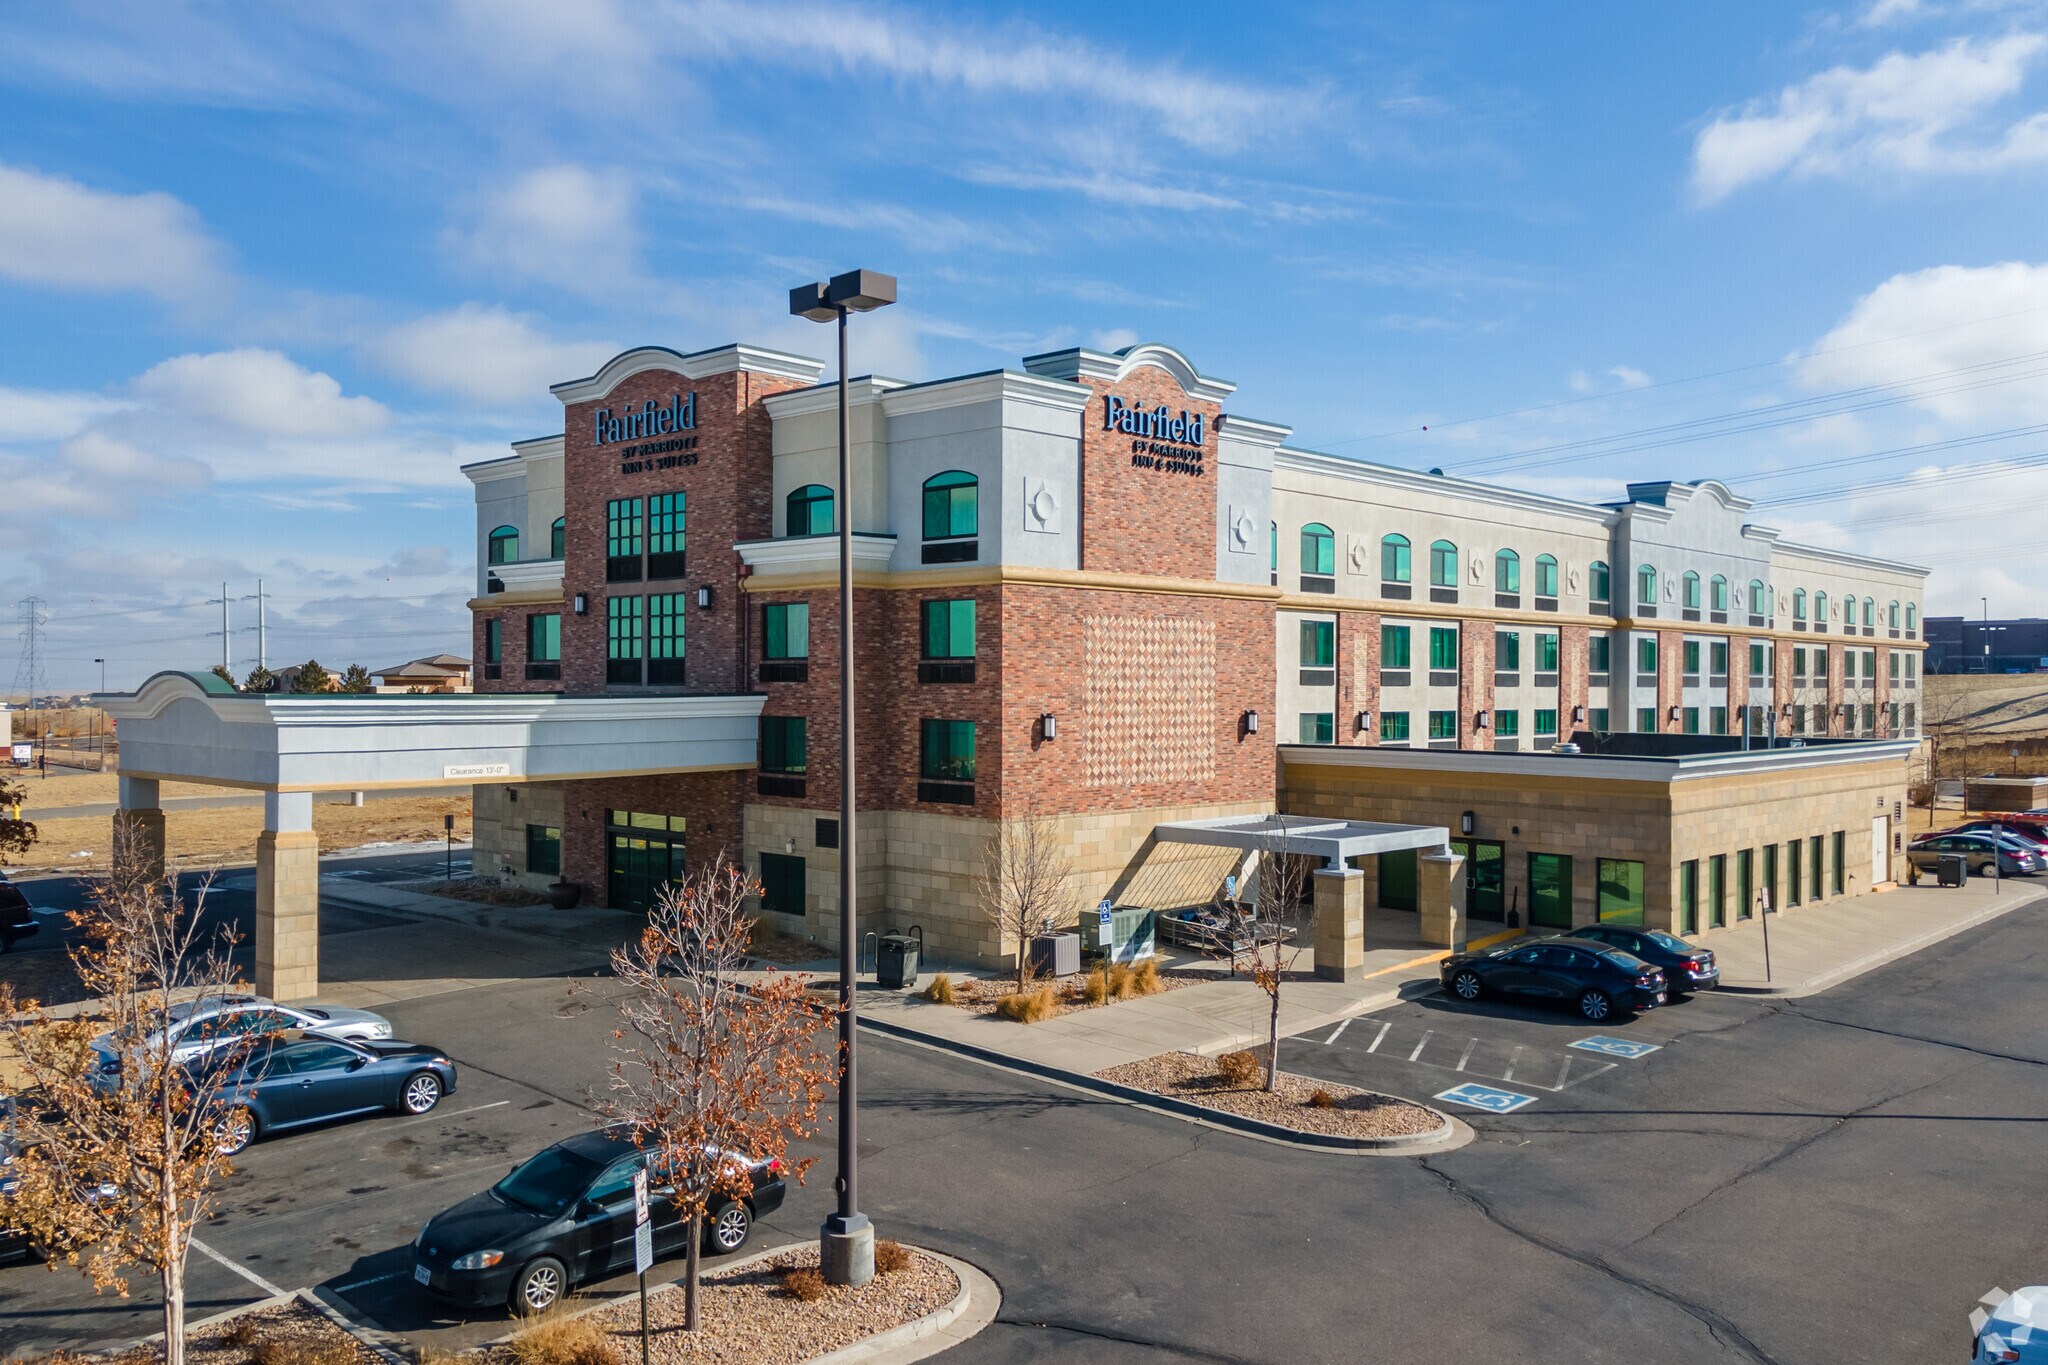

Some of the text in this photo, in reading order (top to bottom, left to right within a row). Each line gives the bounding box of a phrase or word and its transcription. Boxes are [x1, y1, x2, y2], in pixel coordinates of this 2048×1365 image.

[594, 391, 696, 446] Fairfield
[1104, 394, 1205, 446] Fairfield
[621, 436, 698, 459] BY MARRIOTT
[1135, 440, 1204, 462] BY MARRIOTT
[1135, 454, 1155, 469] INN
[450, 767, 484, 776] Clearance
